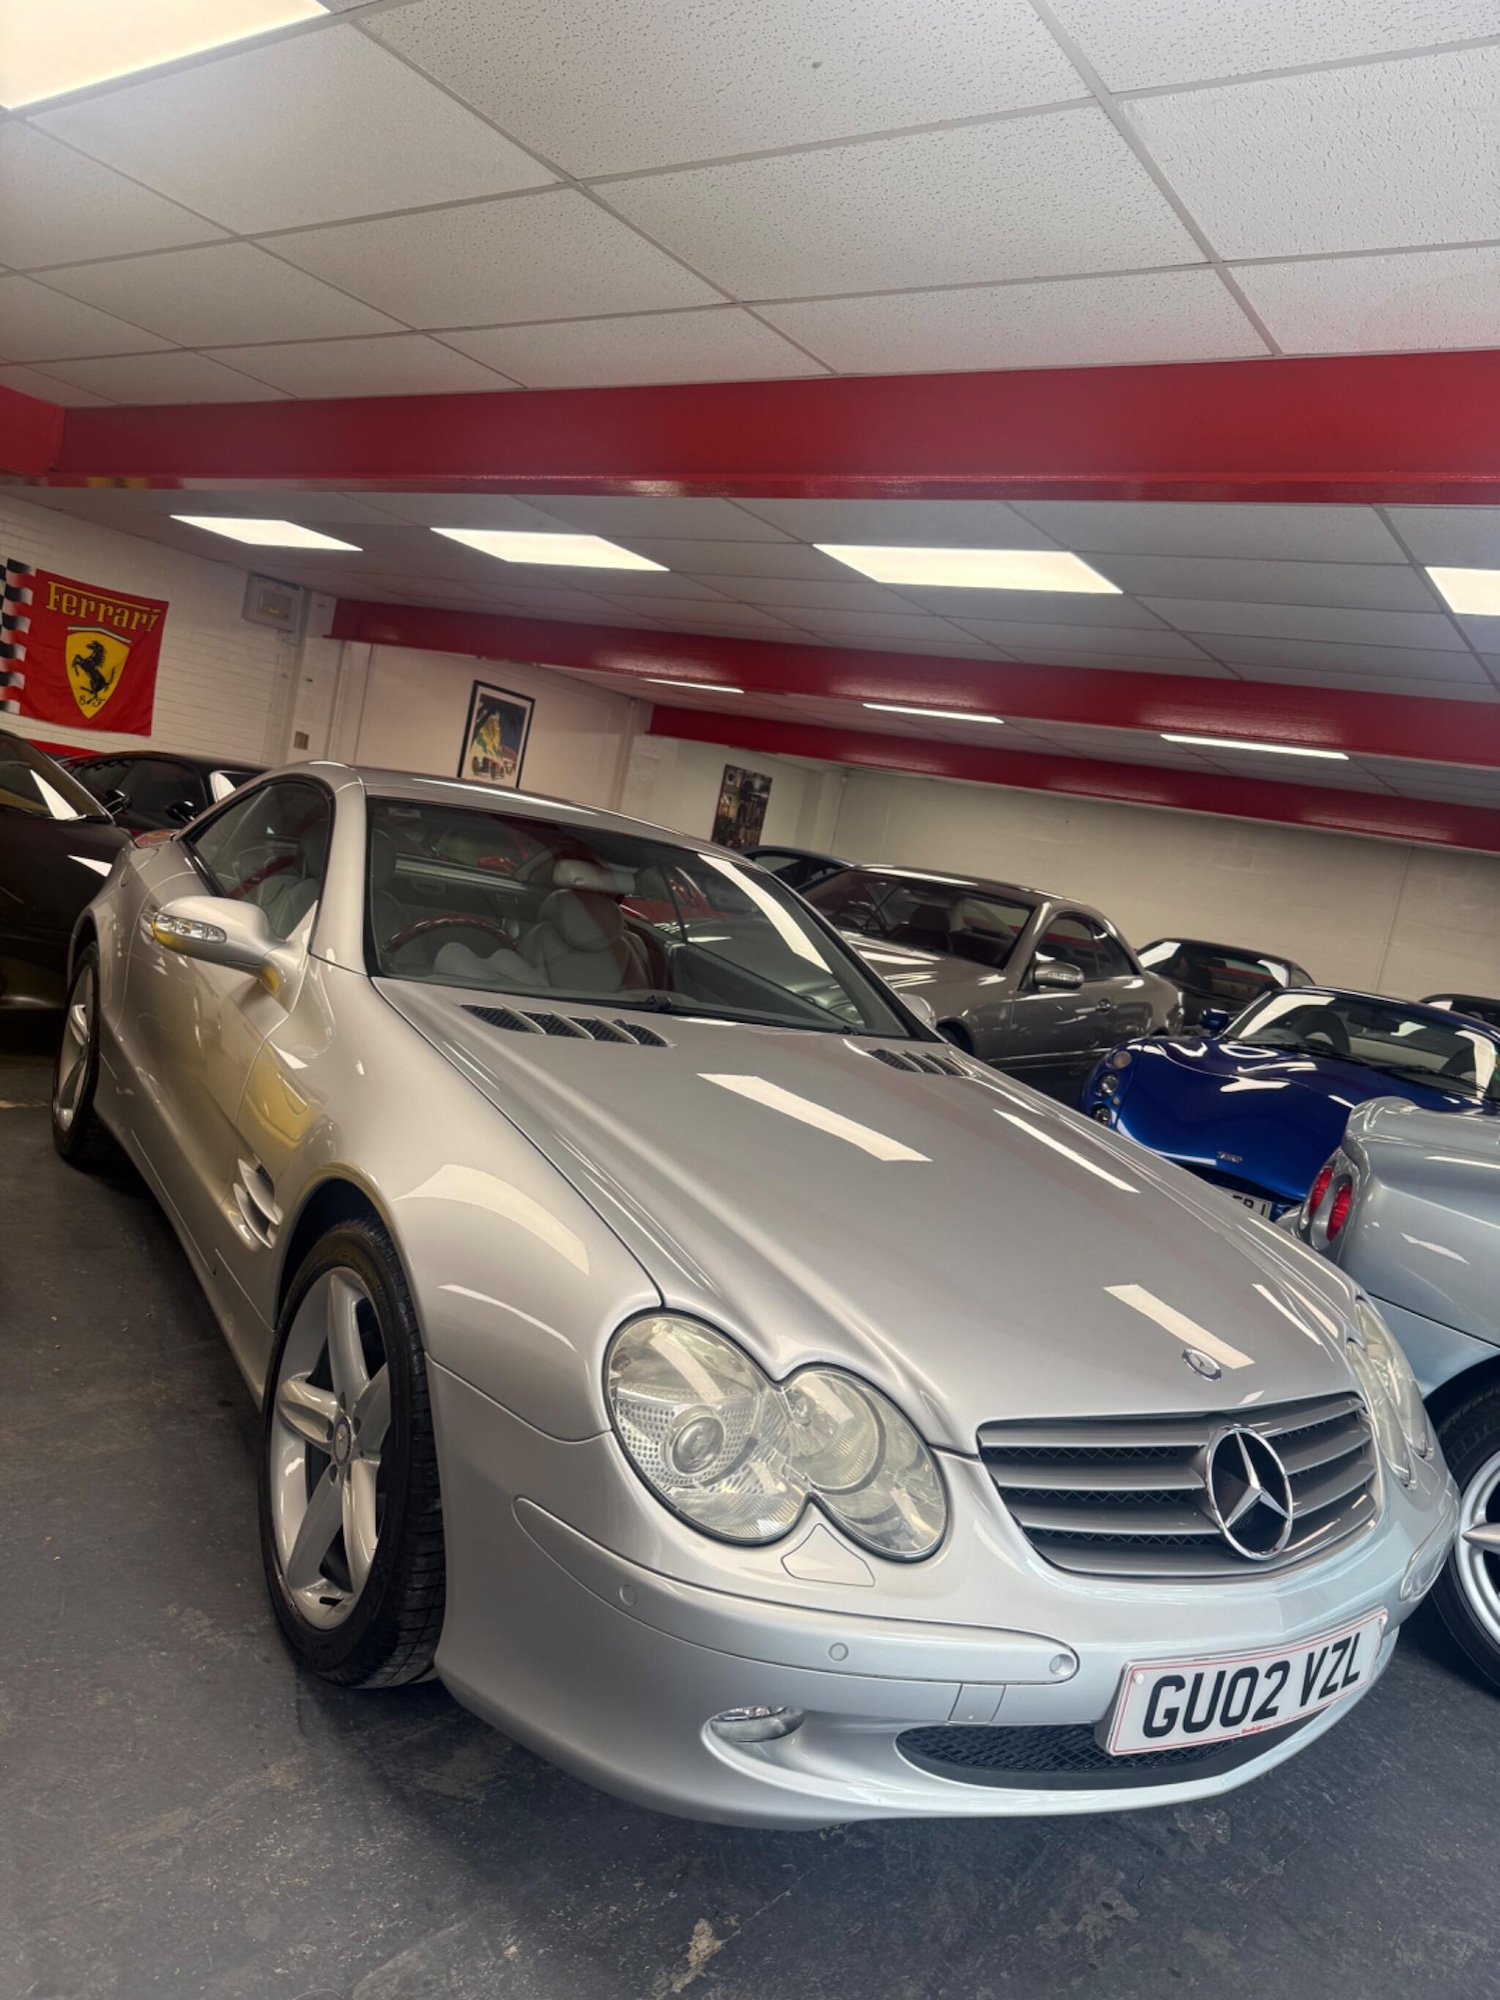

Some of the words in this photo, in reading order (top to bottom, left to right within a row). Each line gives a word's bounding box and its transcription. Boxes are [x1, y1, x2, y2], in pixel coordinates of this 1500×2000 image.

[45, 580, 162, 632] Ferrari
[1142, 1659, 1291, 1739] GU02
[1299, 1631, 1361, 1708] VZL
